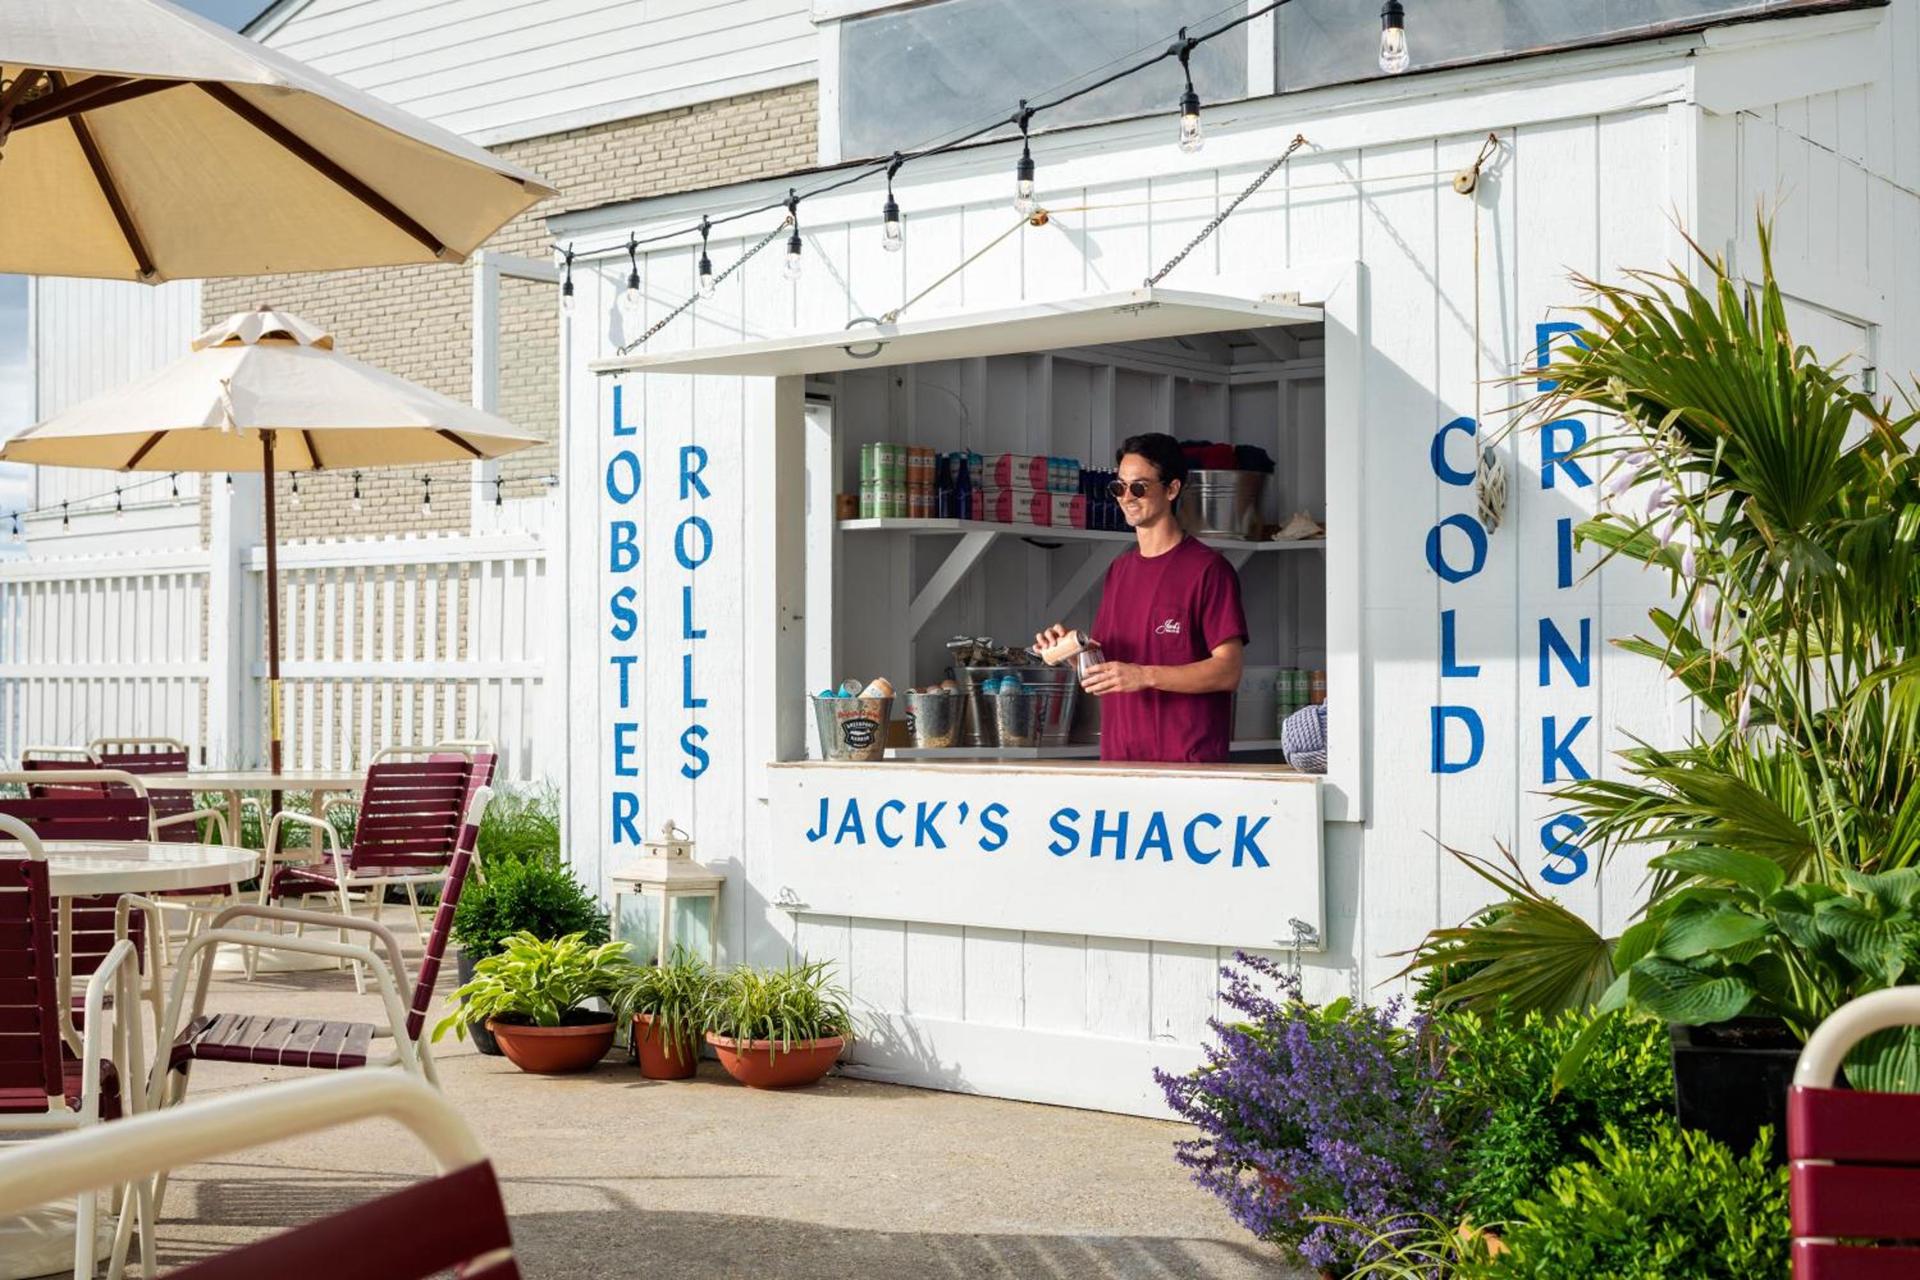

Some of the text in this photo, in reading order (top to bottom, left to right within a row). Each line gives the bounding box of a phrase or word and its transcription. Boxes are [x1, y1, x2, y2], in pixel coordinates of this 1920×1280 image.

[606, 385, 641, 845] LOBSTER
[674, 445, 713, 779] ROLLS
[1426, 416, 1488, 774] COLD
[1536, 322, 1593, 885] DRINKS
[806, 797, 1271, 868] JACK'S SHACK
